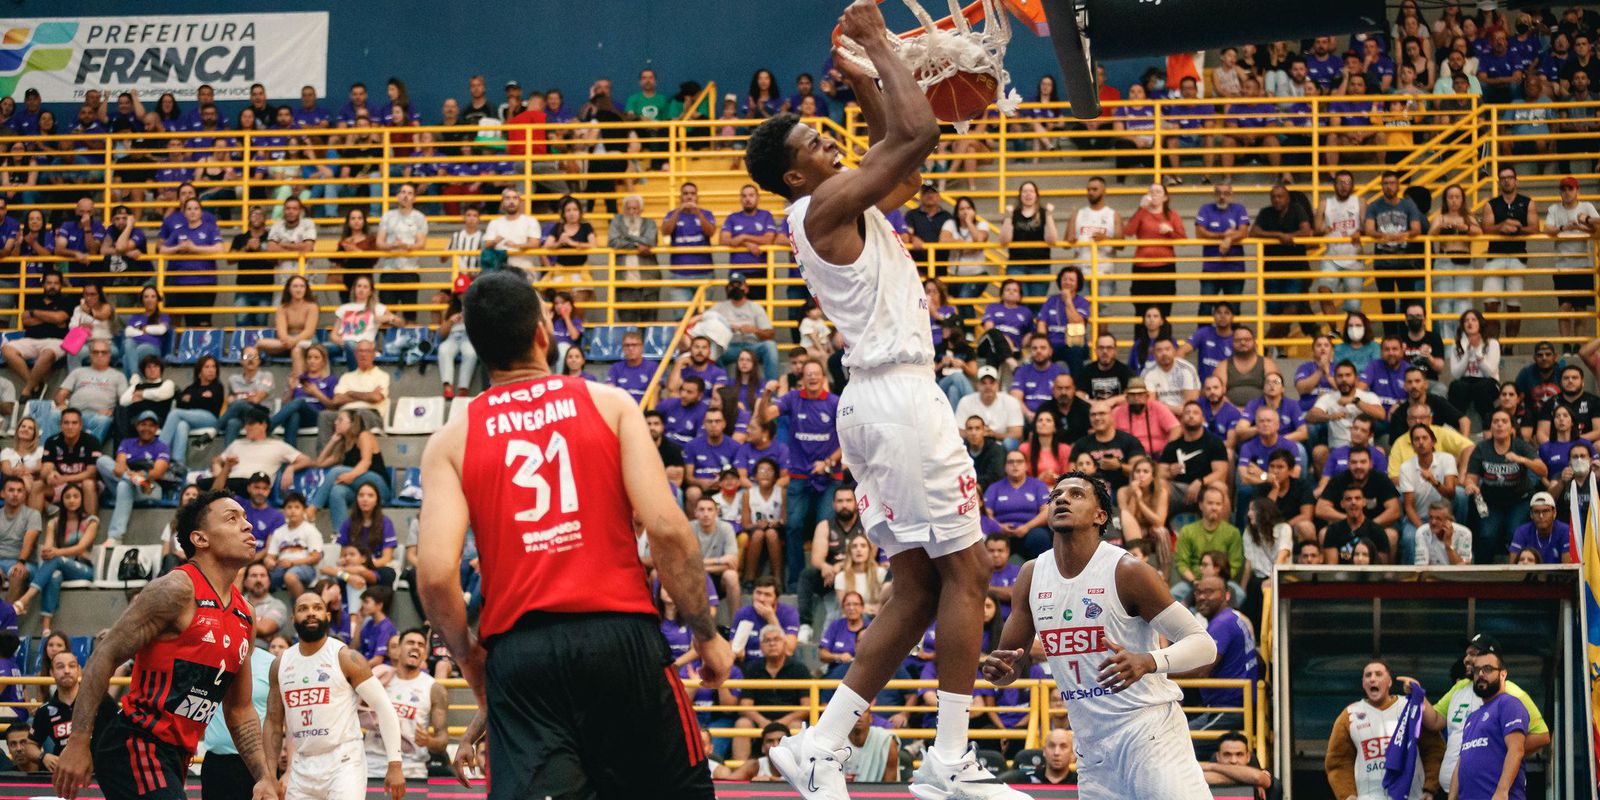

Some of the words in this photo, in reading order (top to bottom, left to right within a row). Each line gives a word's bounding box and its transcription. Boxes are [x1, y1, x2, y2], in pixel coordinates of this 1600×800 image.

[86, 22, 256, 43] PREFEITURA
[74, 45, 256, 84] FRANCA
[485, 398, 577, 437] FAVERANI
[504, 430, 579, 522] 31
[524, 542, 549, 553] FAN
[1045, 629, 1098, 655] SESI
[213, 658, 226, 686] 2
[1068, 660, 1081, 684] 7
[190, 686, 209, 697] banco
[288, 689, 326, 707] SESI
